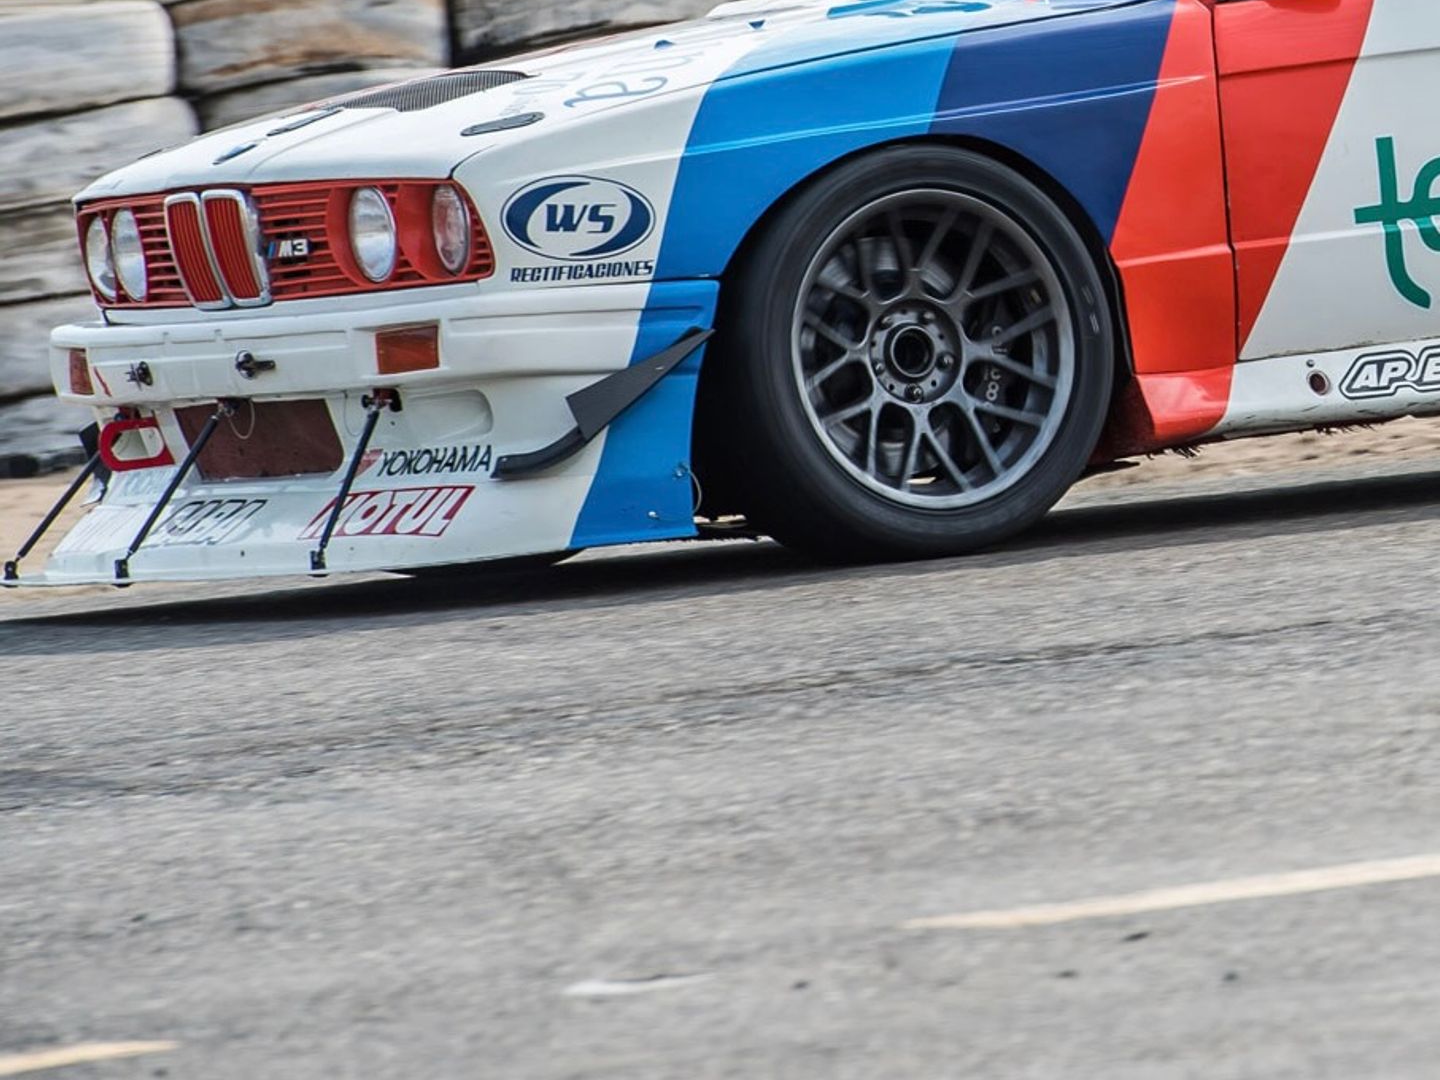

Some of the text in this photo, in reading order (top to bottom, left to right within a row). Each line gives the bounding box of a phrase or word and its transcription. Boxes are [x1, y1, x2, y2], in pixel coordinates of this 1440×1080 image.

[545, 204, 617, 234] WS
[510, 259, 654, 283] RECTIFICACIONES
[376, 444, 493, 478] YOKOHAMA
[297, 485, 476, 540] MOTUL
